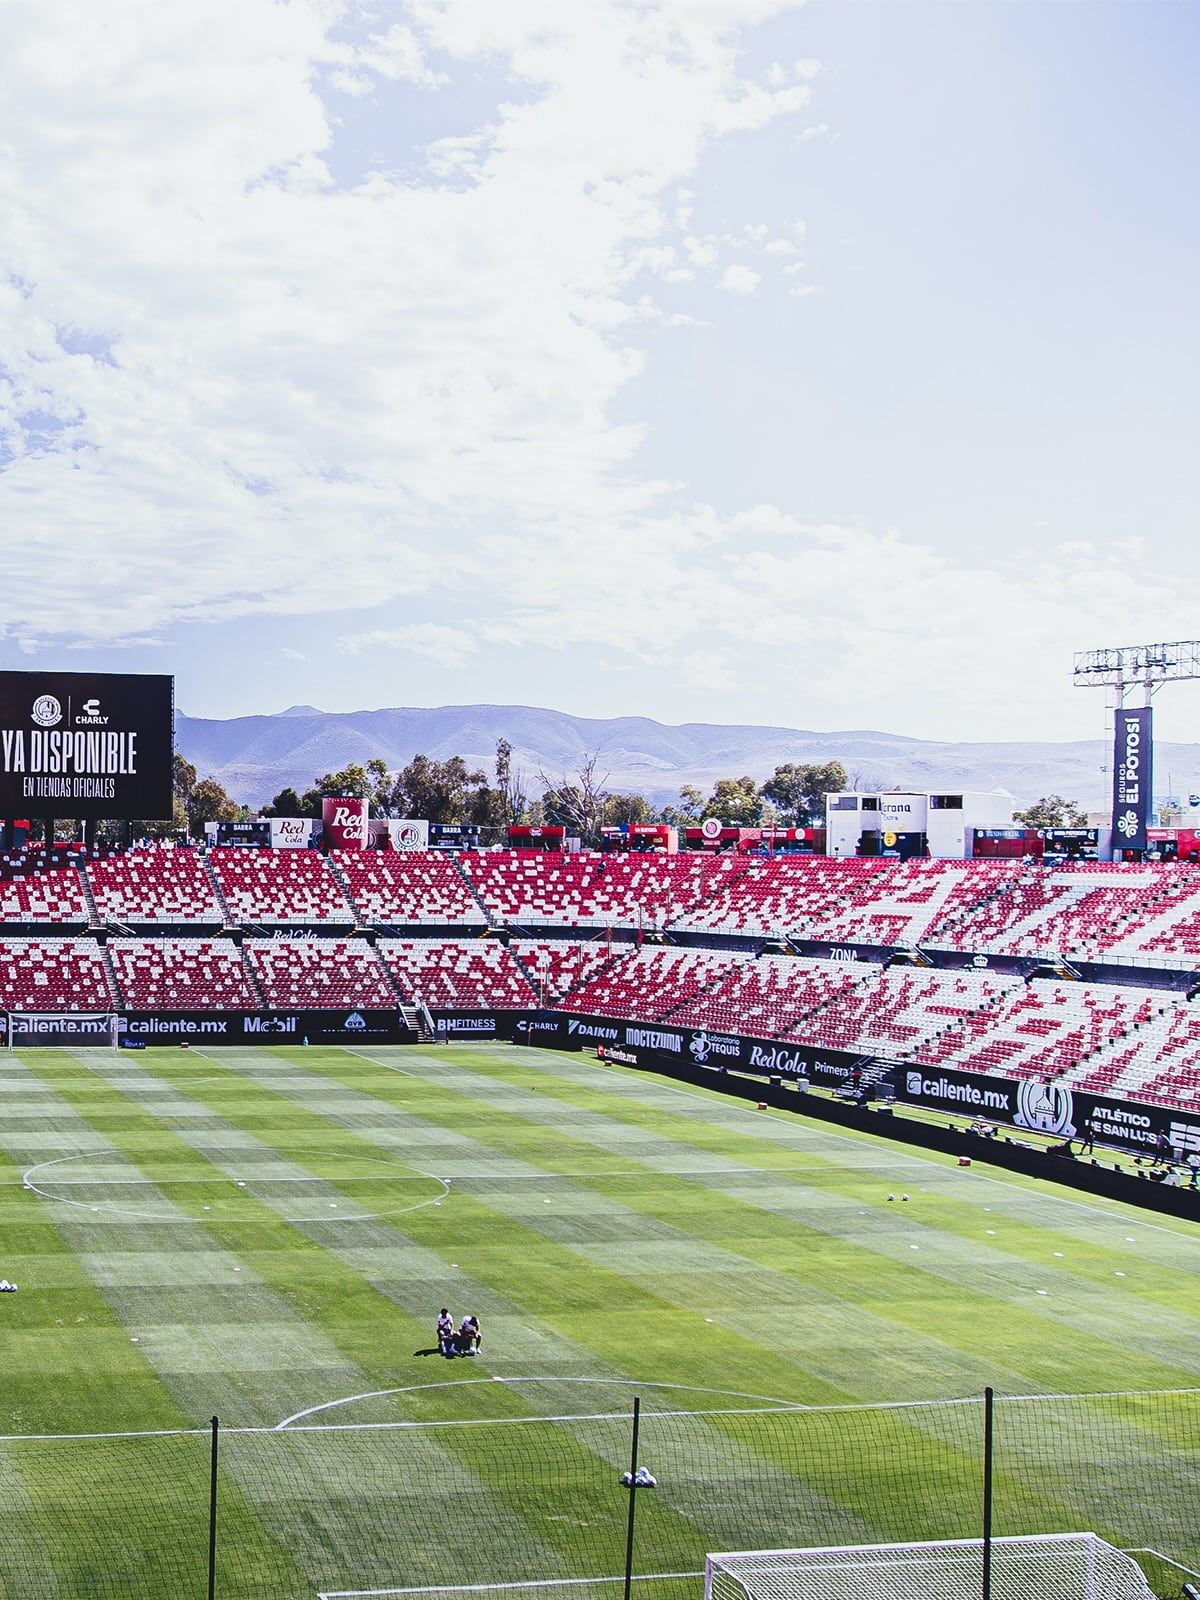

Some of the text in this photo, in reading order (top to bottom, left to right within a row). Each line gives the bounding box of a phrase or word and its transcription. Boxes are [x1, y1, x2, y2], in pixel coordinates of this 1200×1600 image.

[75, 716, 109, 725] CHARLY
[1, 730, 138, 774] YA DISPONIBLE
[23, 777, 115, 798] EN TIENDAS OFICIALES
[1126, 783, 1139, 804] EL
[331, 807, 367, 827] Red
[279, 820, 305, 835] Red
[442, 826, 462, 834] BARRA
[285, 834, 303, 844] Cola
[829, 947, 858, 961] ZONA
[9, 1018, 108, 1033] caliente.mx
[129, 1017, 227, 1033] caliente.mx
[529, 1022, 559, 1031] CHARLY
[577, 1024, 618, 1040] DAIKIN
[711, 1043, 741, 1057] TEQUIS
[814, 1061, 849, 1077] Primera
[922, 1078, 1009, 1111] caliente.mx
[1091, 1106, 1151, 1128] ATLÉTICO
[1103, 1122, 1129, 1139] SAN
